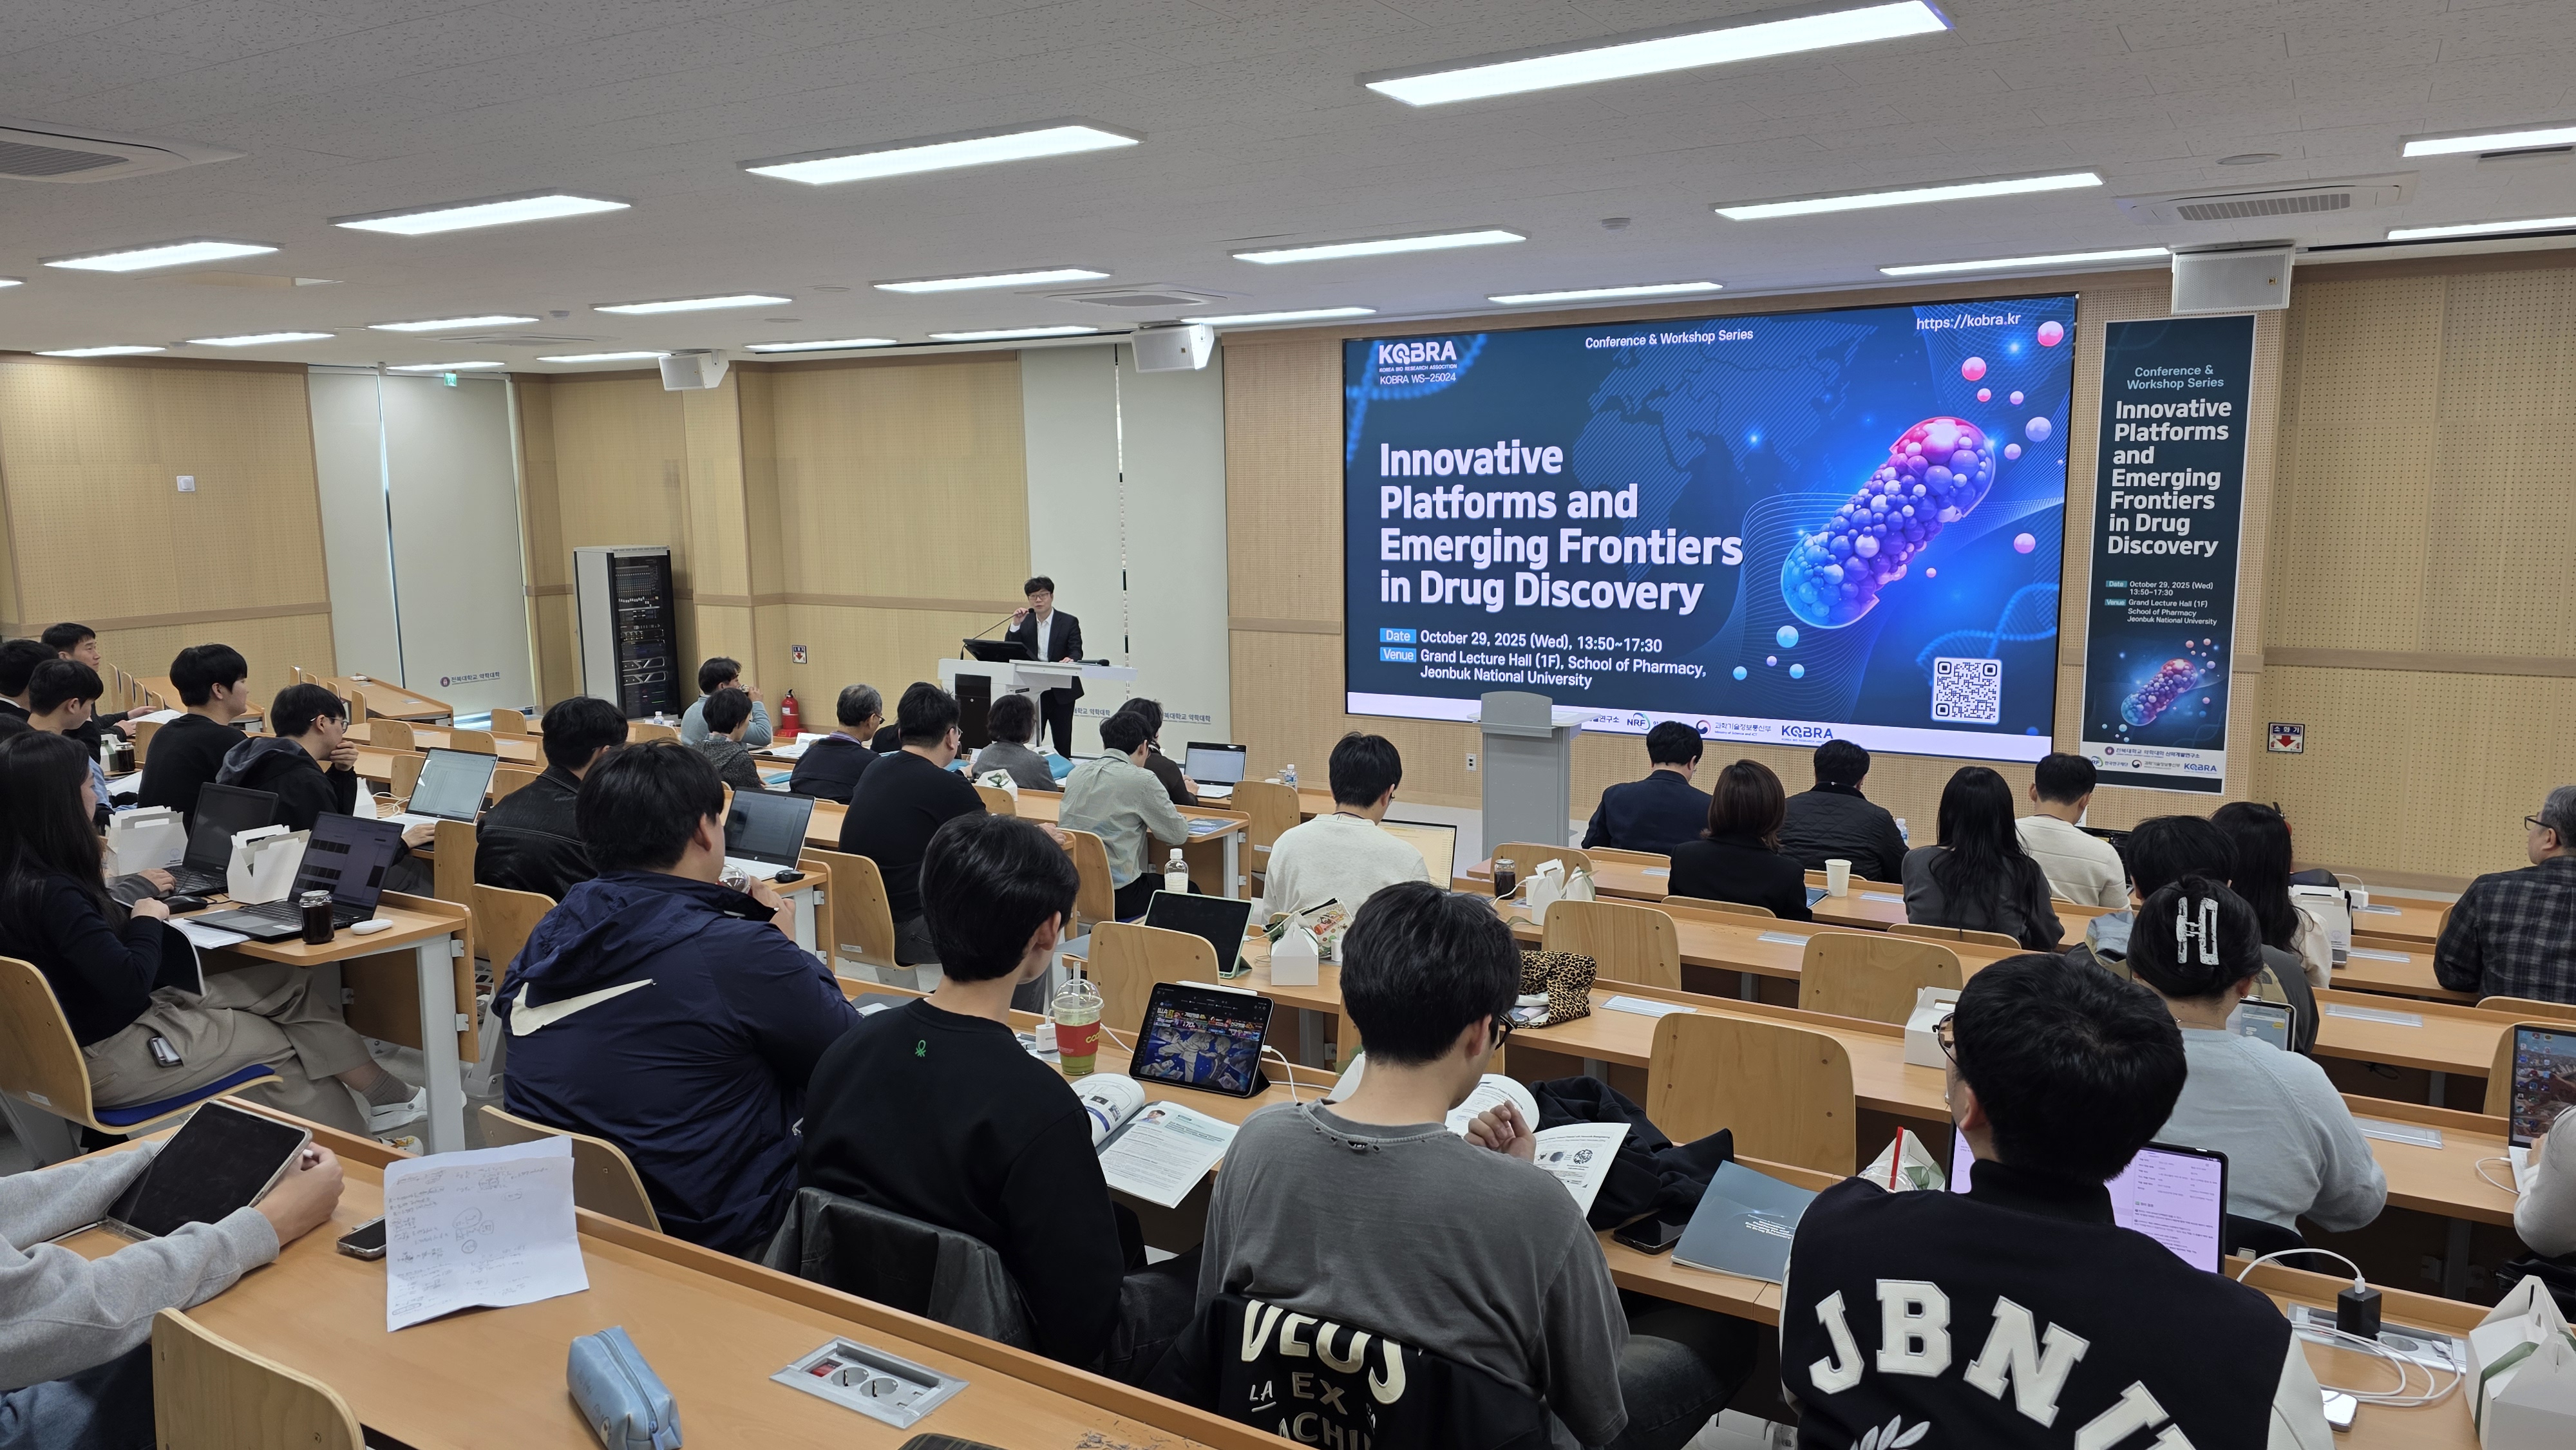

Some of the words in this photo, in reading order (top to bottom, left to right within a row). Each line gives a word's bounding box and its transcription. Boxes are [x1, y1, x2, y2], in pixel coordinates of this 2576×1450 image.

[1917, 312, 2021, 332] https://kobra.kr
[1585, 335, 1646, 348] Conference
[1649, 333, 1657, 344] &
[1660, 330, 1715, 344] Workshop
[1718, 328, 1754, 341] Series
[1380, 375, 1409, 384] KOBRA
[1412, 372, 1456, 383] WS-25024
[2135, 366, 2201, 377] Conference
[2204, 364, 2213, 374] &
[2126, 379, 2184, 390] Workshop
[2187, 377, 2224, 388] Series
[2116, 399, 2232, 419] Innovative
[2114, 422, 2229, 442] Platforms
[1380, 439, 1564, 476] Innovative
[2113, 446, 2154, 464] and
[2112, 467, 2221, 490] Emerging
[1381, 484, 1557, 518] Platforms
[1567, 483, 1638, 518] and
[2110, 491, 2215, 509] Frontiers
[2109, 513, 2129, 531] in
[2136, 513, 2190, 536] Drug
[1381, 527, 1548, 569] Emerging
[1560, 528, 1744, 565] Frontiers
[2108, 536, 2219, 557] Discovery
[1381, 569, 1410, 603] in
[1420, 570, 1504, 613] Drug
[1515, 572, 1704, 615] Discovery
[2192, 581, 2213, 590] (Wed)
[2161, 609, 2197, 617] Pharmacy
[2184, 617, 2217, 626] University
[1386, 630, 1410, 641] Date
[1421, 630, 1468, 644] October
[1471, 632, 1490, 647] 29,
[1494, 633, 1526, 647] 2025
[1530, 633, 1573, 650] (Wed),
[1383, 648, 1414, 660] Venue
[1421, 649, 1456, 663] Grand
[1459, 651, 1506, 666] Lecture
[1509, 653, 1532, 666] Hall
[1535, 652, 1564, 670] (1F),
[1568, 655, 1612, 671] School
[1616, 658, 1630, 672] of
[1633, 659, 1707, 679] Pharmacy,
[479, 671, 500, 679] 약학대학
[1420, 665, 1471, 680] Jeonbuk
[1474, 668, 1524, 683] National
[1527, 670, 1593, 690] University
[1715, 722, 1771, 732] 과학기술정보통신부
[1249, 1380, 1273, 1402] LA
[1292, 1371, 1348, 1415] EX
